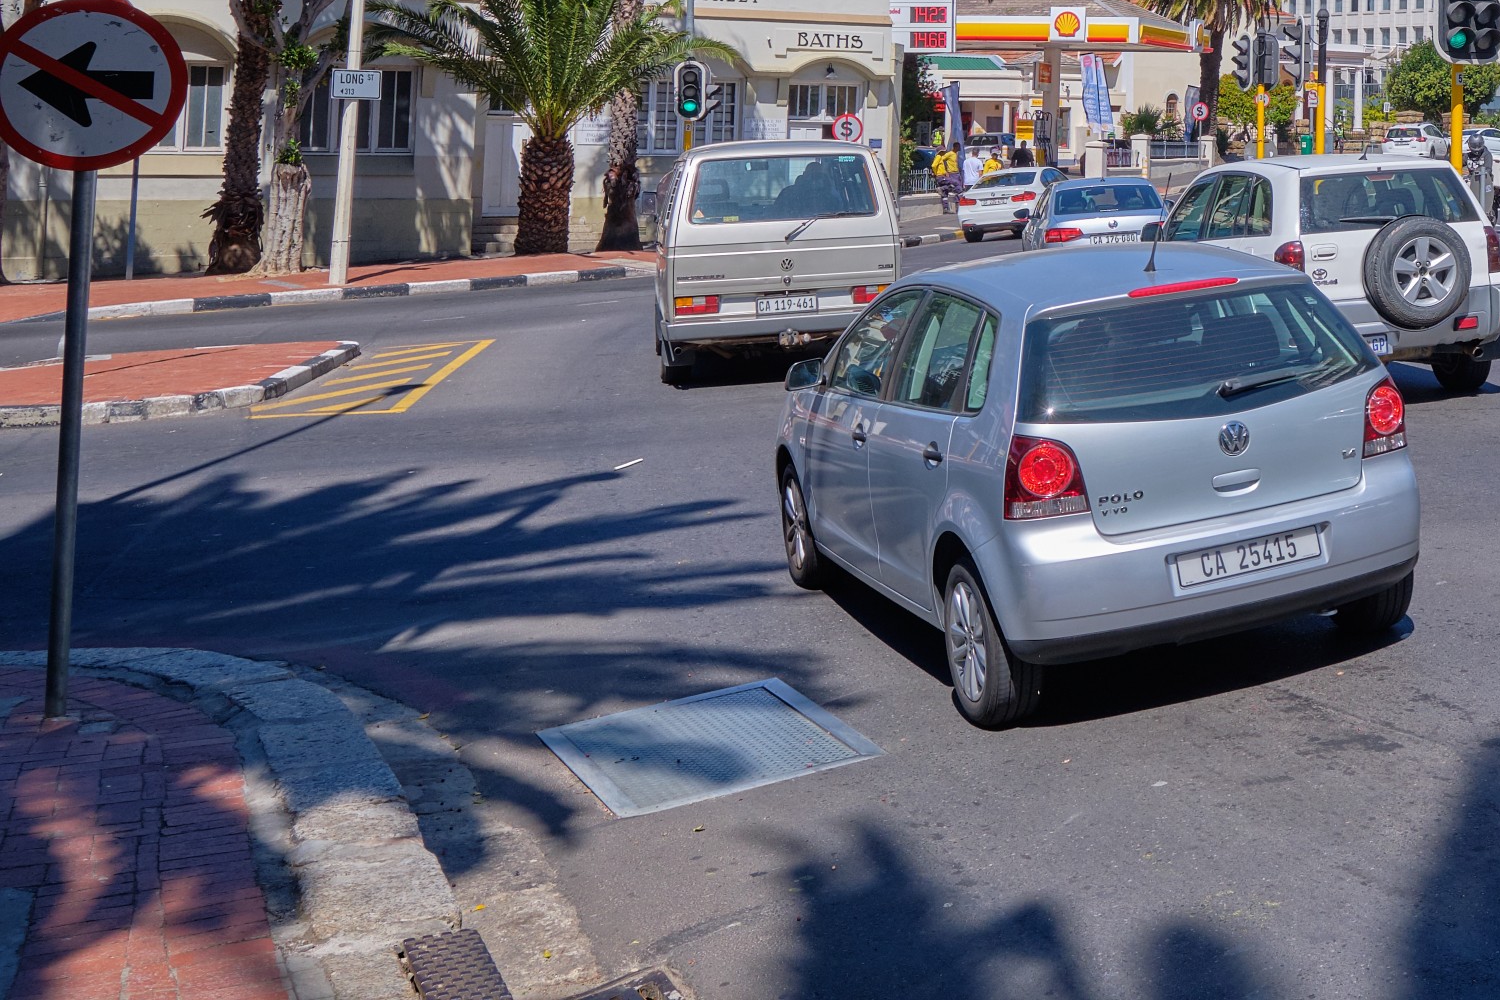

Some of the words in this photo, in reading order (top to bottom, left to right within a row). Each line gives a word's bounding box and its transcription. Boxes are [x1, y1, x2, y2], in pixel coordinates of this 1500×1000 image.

[913, 6, 948, 23] 14.23
[797, 31, 863, 49] BATHS
[913, 32, 947, 48] 14.68
[340, 73, 364, 85] LONG
[344, 88, 356, 96] 313
[758, 300, 771, 312] CA
[1372, 337, 1385, 352] GP
[1098, 490, 1144, 507] POLO
[1200, 552, 1227, 578] CA
[1236, 533, 1298, 570] 25415
